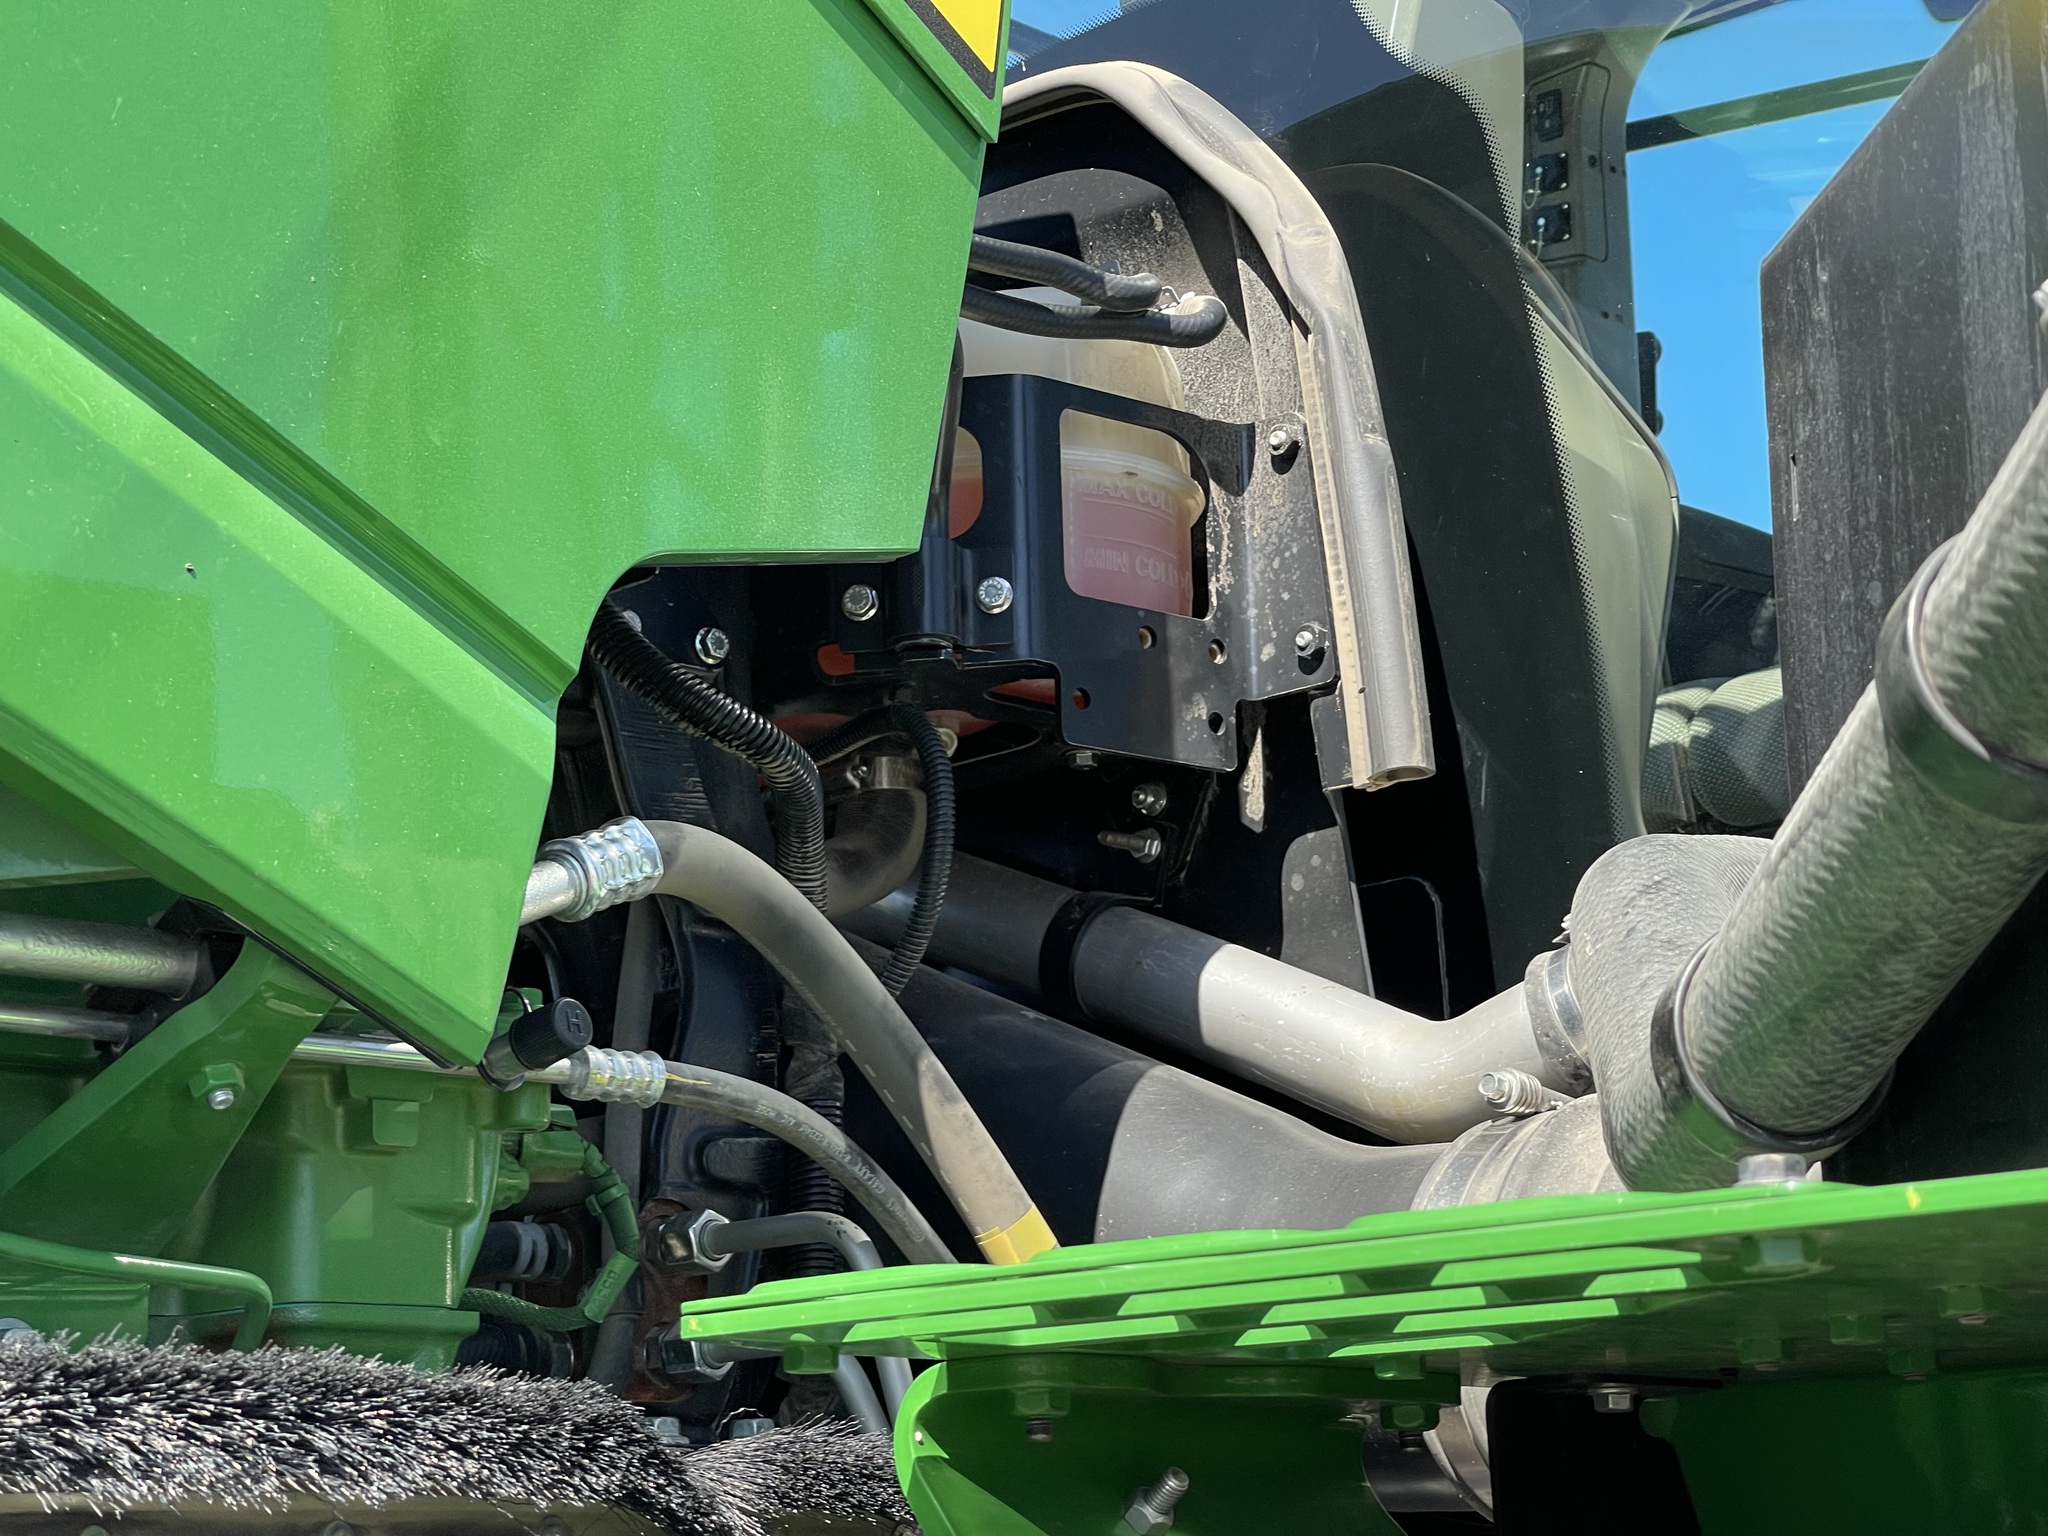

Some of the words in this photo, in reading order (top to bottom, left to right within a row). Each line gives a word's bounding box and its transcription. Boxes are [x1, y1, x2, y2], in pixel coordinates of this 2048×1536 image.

[1079, 478, 1130, 499] MAX
[1085, 547, 1129, 573] MIN
[1135, 554, 1178, 587] COLD
[565, 1008, 584, 1036] H
[755, 1103, 777, 1119] HOSE
[780, 1114, 796, 1126] A/C
[853, 1161, 885, 1194] GALAXY
